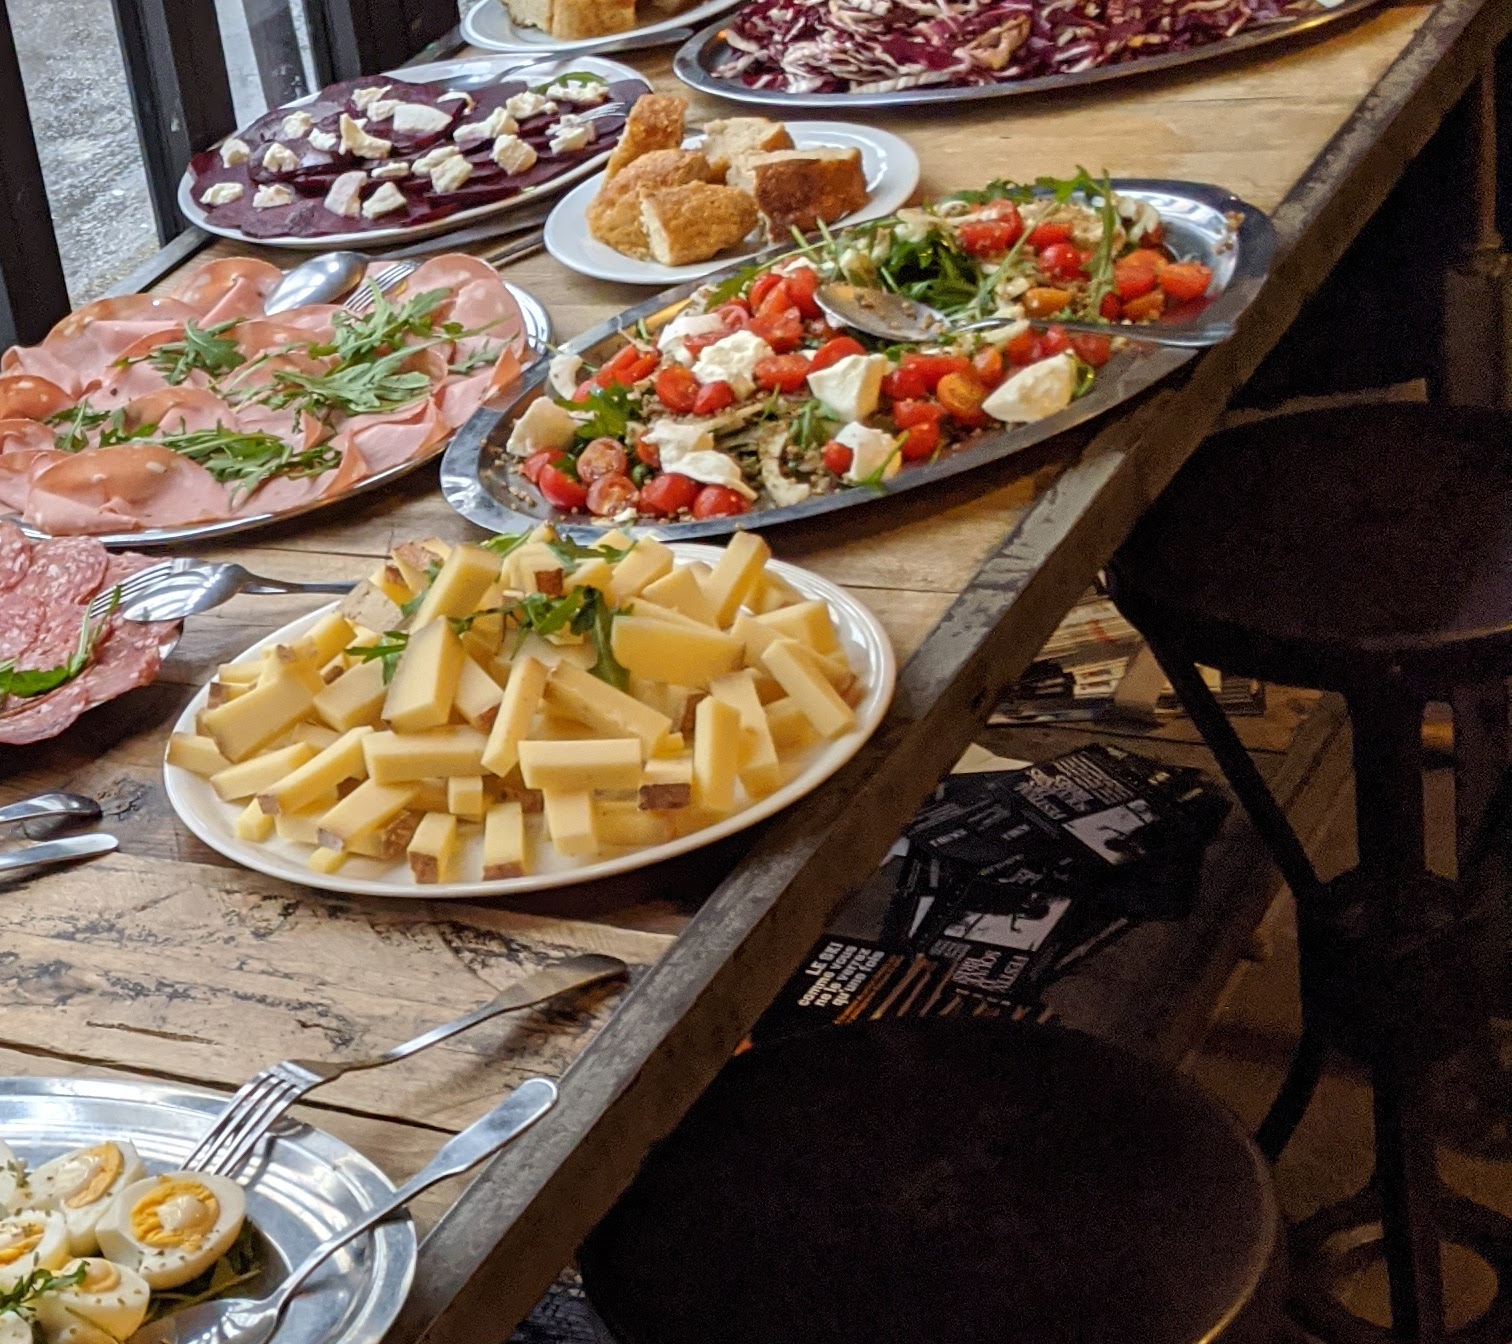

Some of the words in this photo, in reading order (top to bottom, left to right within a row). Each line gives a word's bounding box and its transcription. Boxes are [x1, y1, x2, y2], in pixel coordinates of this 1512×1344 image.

[804, 960, 829, 976] LE
[797, 971, 836, 1007] comme
[829, 945, 858, 970] vous
[822, 981, 842, 993] le
[813, 993, 833, 1007] ne
